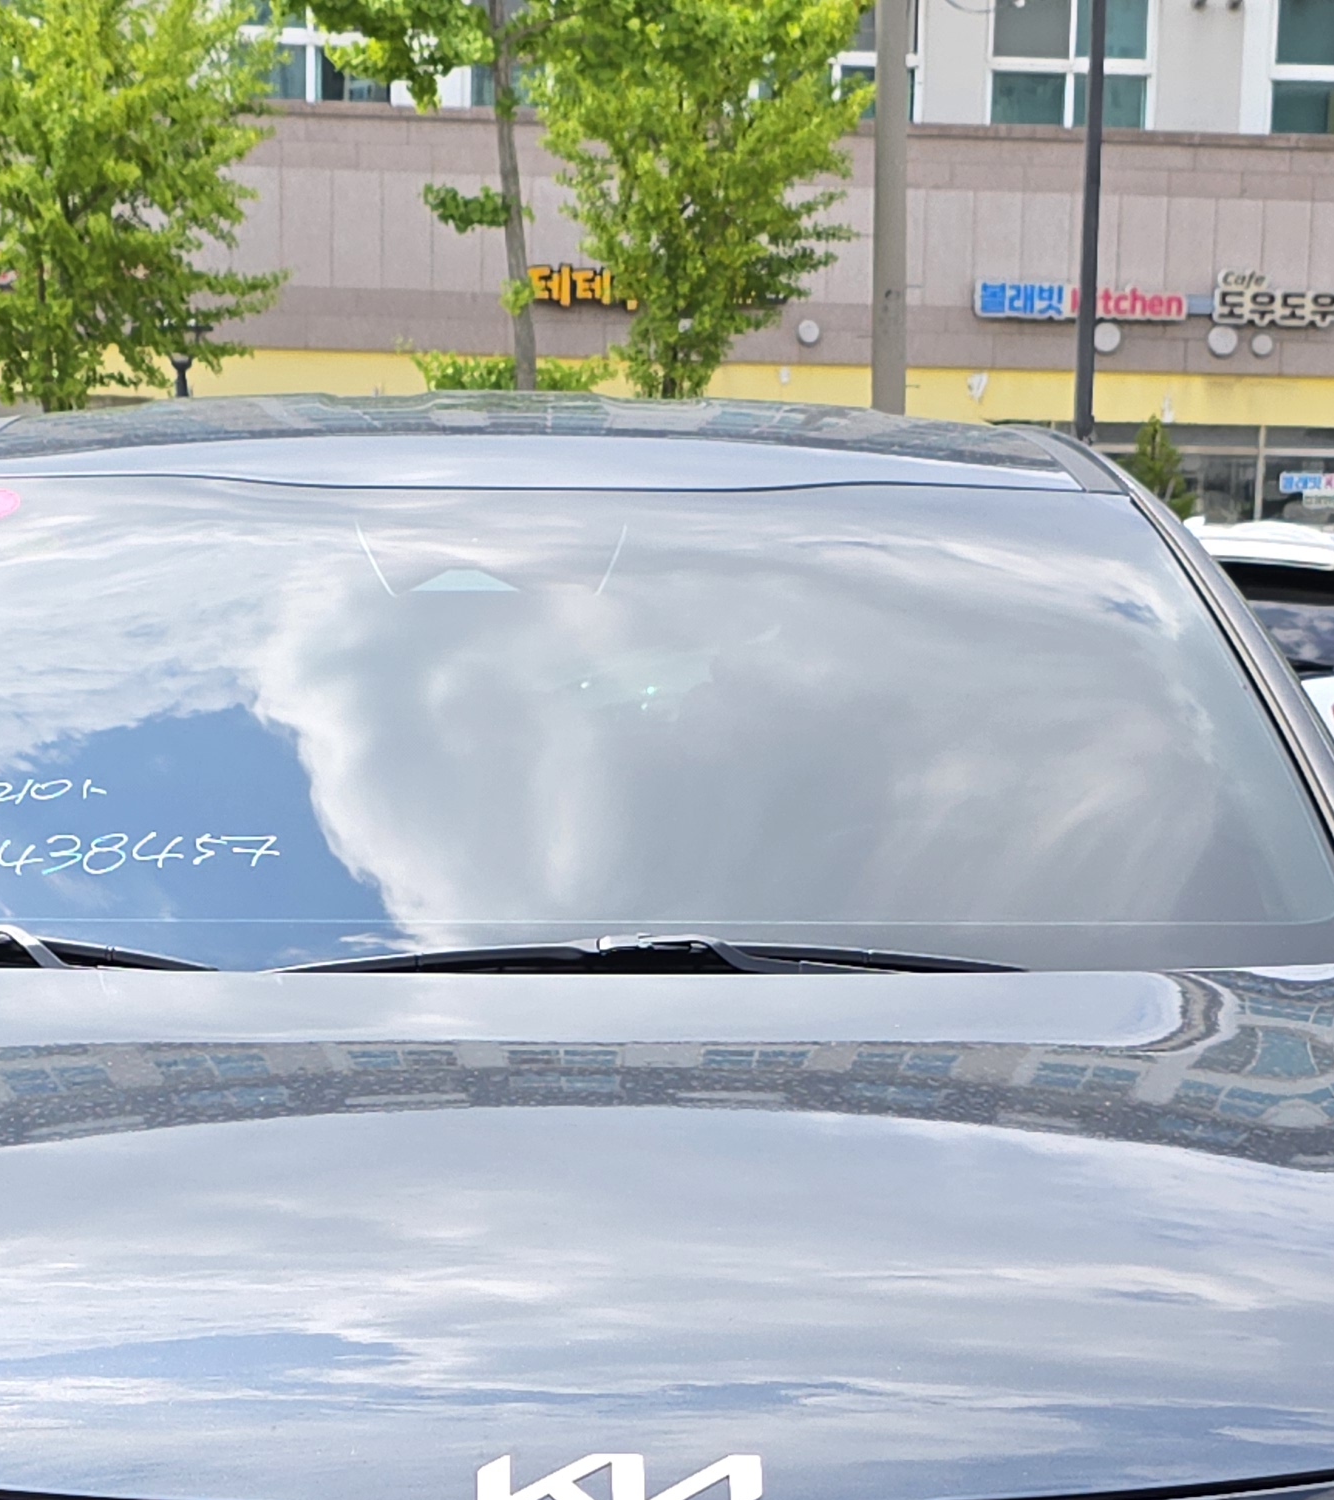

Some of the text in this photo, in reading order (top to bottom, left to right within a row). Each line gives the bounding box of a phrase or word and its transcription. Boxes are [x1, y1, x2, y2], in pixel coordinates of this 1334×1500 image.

[1222, 270, 1267, 287] Cafe
[979, 282, 1184, 317] 볼래빗 tchen
